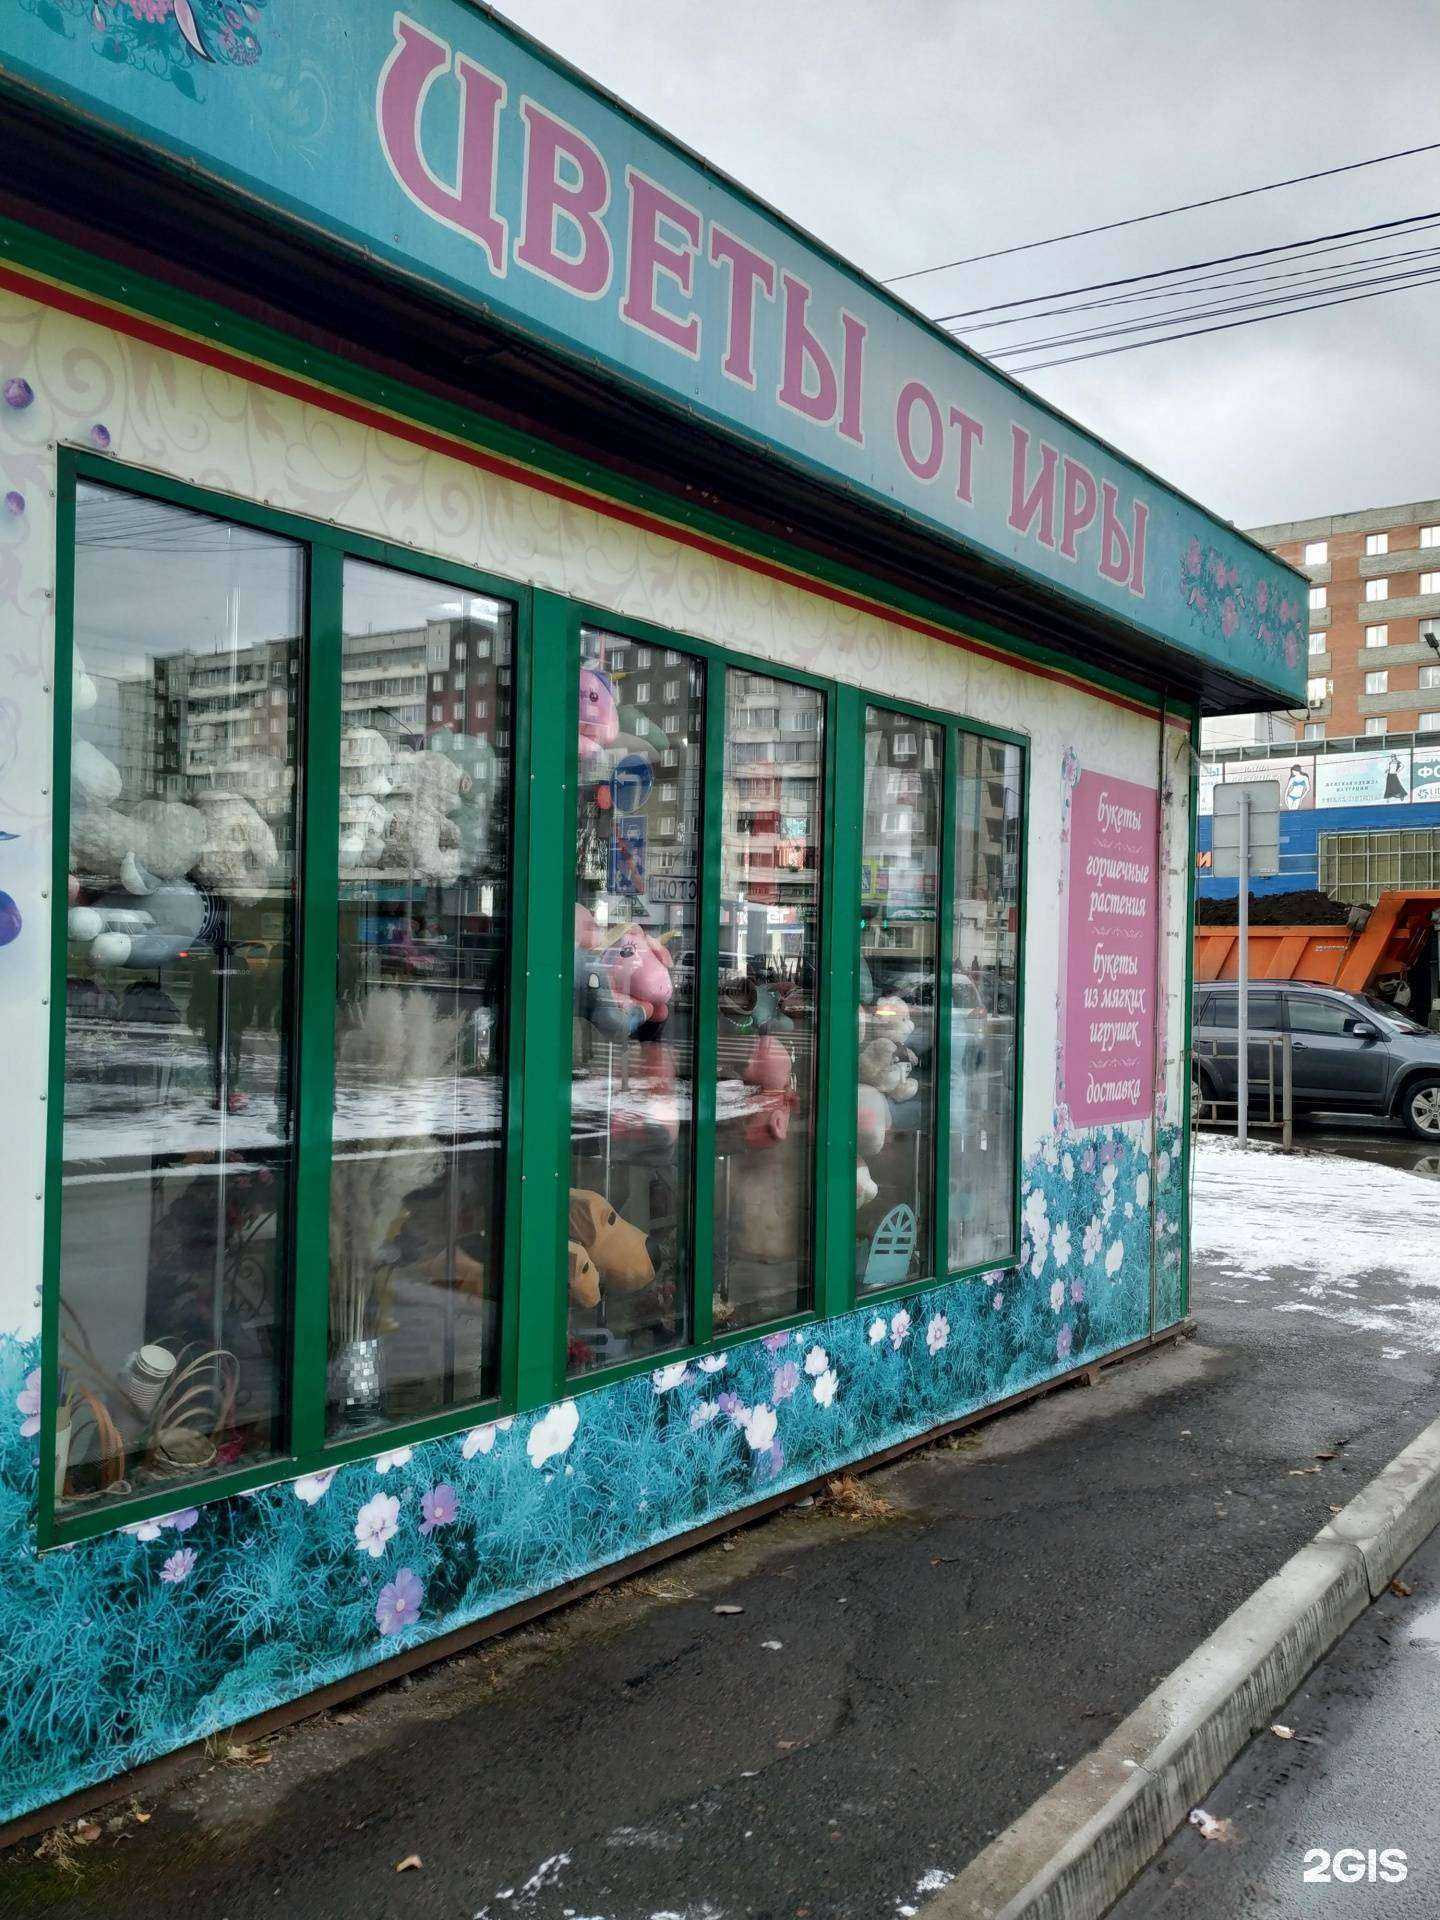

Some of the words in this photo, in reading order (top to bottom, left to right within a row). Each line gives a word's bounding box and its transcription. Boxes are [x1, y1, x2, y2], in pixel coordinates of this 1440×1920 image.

[377, 10, 868, 448] ЦВЕТЫ
[895, 378, 984, 508] ОТ
[1007, 421, 1149, 598] ИРЫ
[1098, 792, 1141, 833] букеты
[1086, 855, 1150, 887] горшечные
[1088, 890, 1146, 921] растения
[1093, 943, 1138, 984] букеты
[1084, 987, 1098, 1009] из
[1100, 987, 1146, 1015] мягких
[1090, 1022, 1141, 1051] игрушек
[1086, 1072, 1141, 1105] доставка
